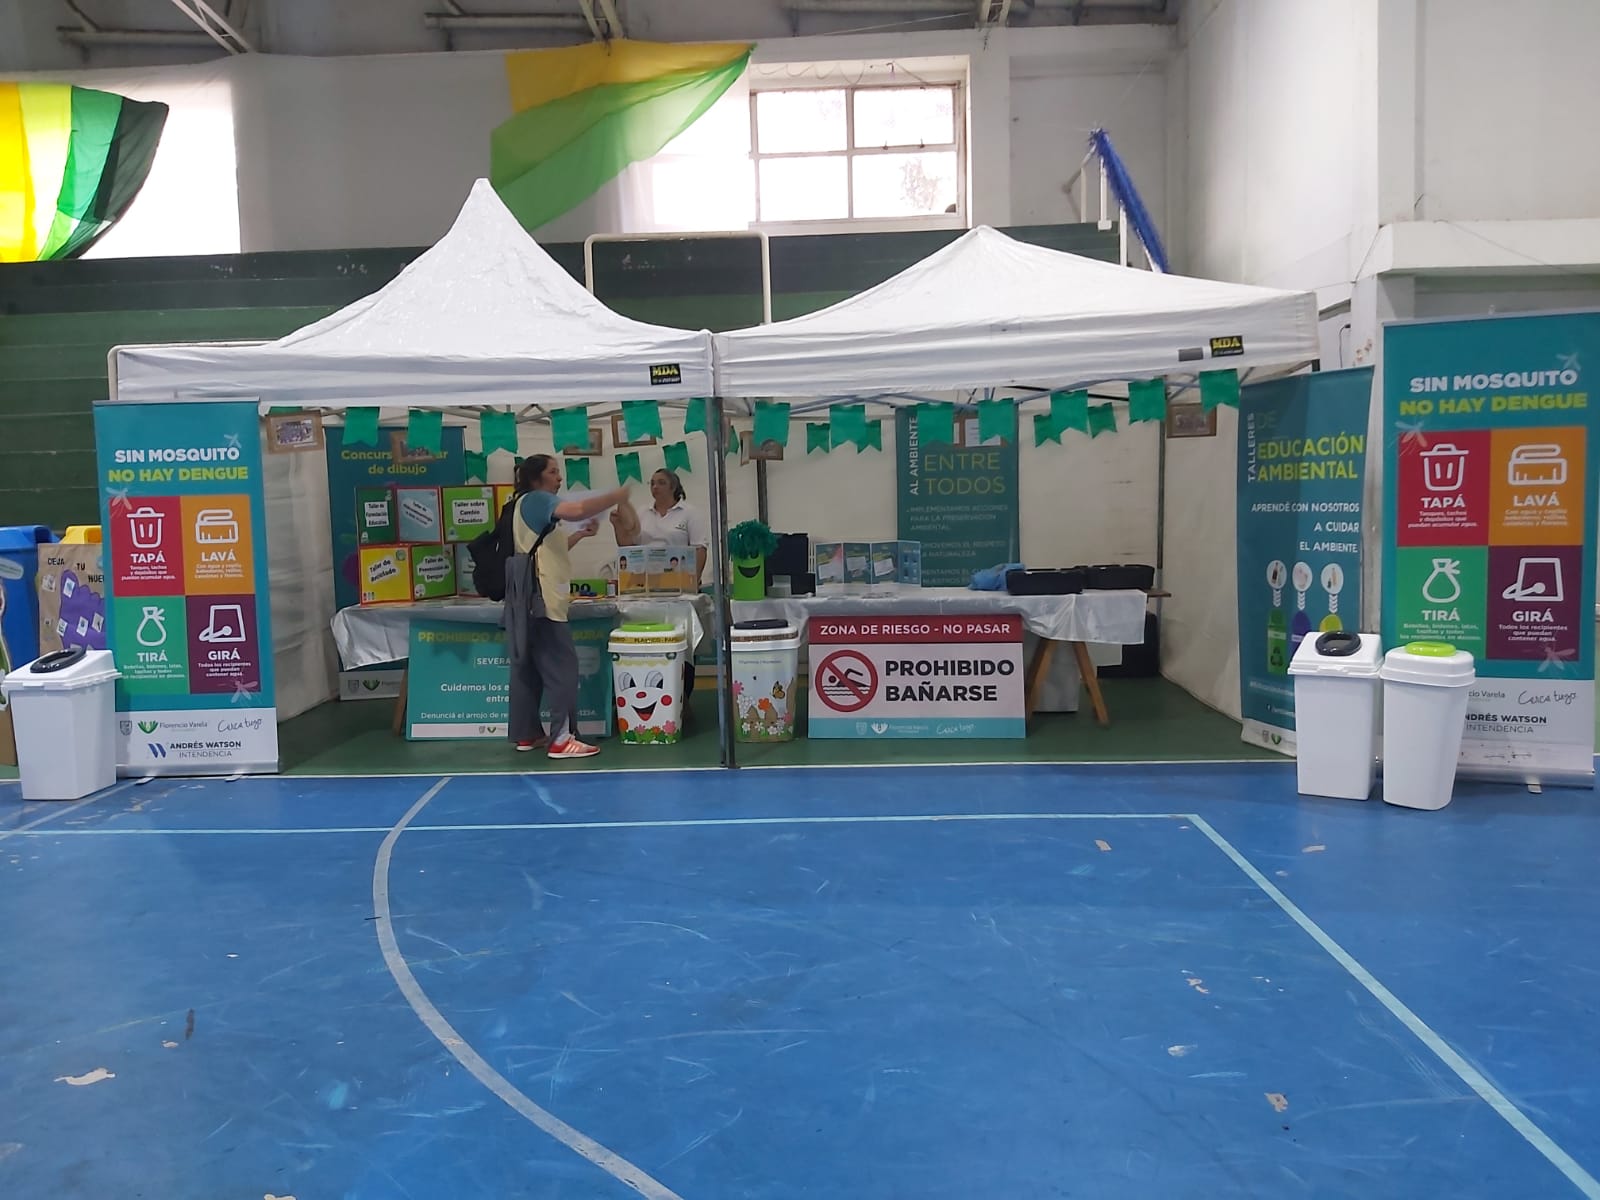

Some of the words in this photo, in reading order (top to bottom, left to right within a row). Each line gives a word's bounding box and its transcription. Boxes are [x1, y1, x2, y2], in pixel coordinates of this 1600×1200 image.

[1212, 337, 1240, 349] MDA
[652, 366, 678, 377] MDA
[1410, 375, 1449, 393] SIN
[1453, 369, 1578, 391] MOSQUITO
[1399, 400, 1434, 416] NO
[1438, 397, 1486, 414] HAY
[1492, 392, 1588, 412] DENGUE
[909, 416, 919, 476] AMBIENTE
[1247, 412, 1256, 483] TALLERES
[1257, 431, 1364, 459] EDUCACIÓN
[114, 449, 144, 463] SIN
[148, 447, 240, 462] MOSQUITO
[341, 451, 392, 460] Concurs
[924, 452, 1001, 472] ENTRE
[108, 469, 135, 482] NO
[140, 468, 174, 482] HAY
[178, 466, 249, 481] DENGUE
[368, 464, 385, 474] de
[387, 464, 427, 476] dibujo
[1257, 460, 1358, 483] AMBIENTAL
[909, 480, 919, 496] AL
[926, 476, 1006, 496] TODOS
[1420, 494, 1466, 508] TAPÁ
[1513, 492, 1560, 507] LAVÁ
[1251, 501, 1290, 512] APRENDÉ
[1291, 502, 1308, 512] CON
[1312, 502, 1360, 513] NOSOTROS
[1313, 522, 1323, 532] A
[1326, 522, 1360, 533] CUIDAR
[1299, 541, 1310, 551] EL
[1312, 542, 1358, 553] AMBIENTE
[48, 558, 64, 566] DEJA
[130, 550, 166, 564] TAPÁ
[201, 550, 236, 562] LAVÁ
[76, 562, 86, 571] TU
[1422, 608, 1461, 622] TIRÁ
[1512, 608, 1554, 622] GIRÁ
[820, 624, 857, 636] ZONA
[861, 624, 878, 635] DE
[882, 624, 930, 635] RIESGO
[943, 623, 964, 634] NO
[967, 622, 1011, 634] PASAR
[1530, 624, 1568, 632] recipientes
[137, 650, 169, 662] TIRÁ
[208, 648, 241, 660] GIRÁ
[885, 660, 1015, 677] PROHIBIDO
[440, 684, 486, 692] Cuidemos
[488, 683, 502, 692] los
[886, 680, 998, 702] BAÑARSE
[1481, 690, 1506, 699] Varela
[420, 712, 456, 720] Denunciá
[466, 712, 488, 720] arrojo
[490, 712, 499, 720] de
[1465, 712, 1498, 722] NDRÉS
[1500, 714, 1547, 724] WATSON
[1466, 724, 1534, 734] INTENDENCIA
[170, 740, 204, 750] ANDRÉS
[205, 740, 242, 750] WATSON
[178, 750, 232, 759] INTENDENCIA
